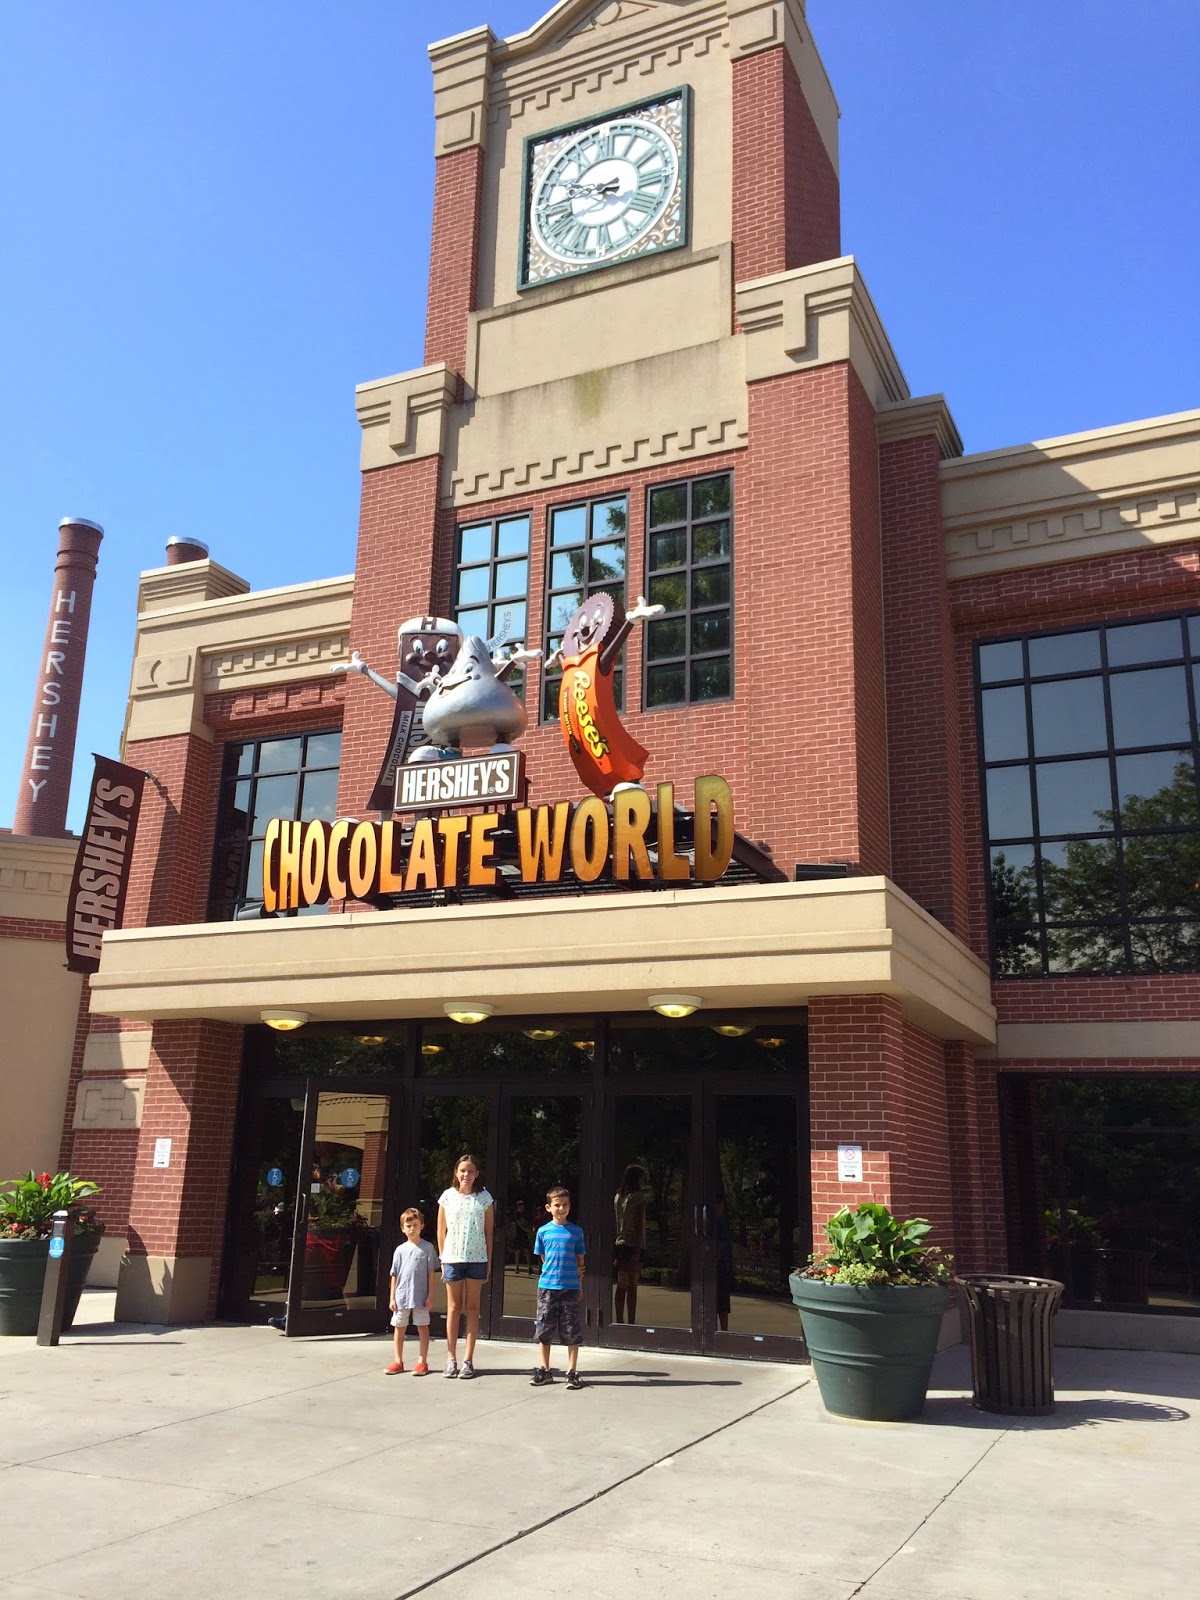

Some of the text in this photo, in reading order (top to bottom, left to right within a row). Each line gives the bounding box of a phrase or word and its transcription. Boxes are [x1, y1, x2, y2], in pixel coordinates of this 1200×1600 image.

[421, 617, 437, 630] H
[29, 590, 76, 802] HERSHEY
[386, 714, 410, 783] MILK CHOCOLATE
[402, 758, 511, 804] HERSHEY'S
[263, 774, 735, 912] CHOCOLATE WORLD
